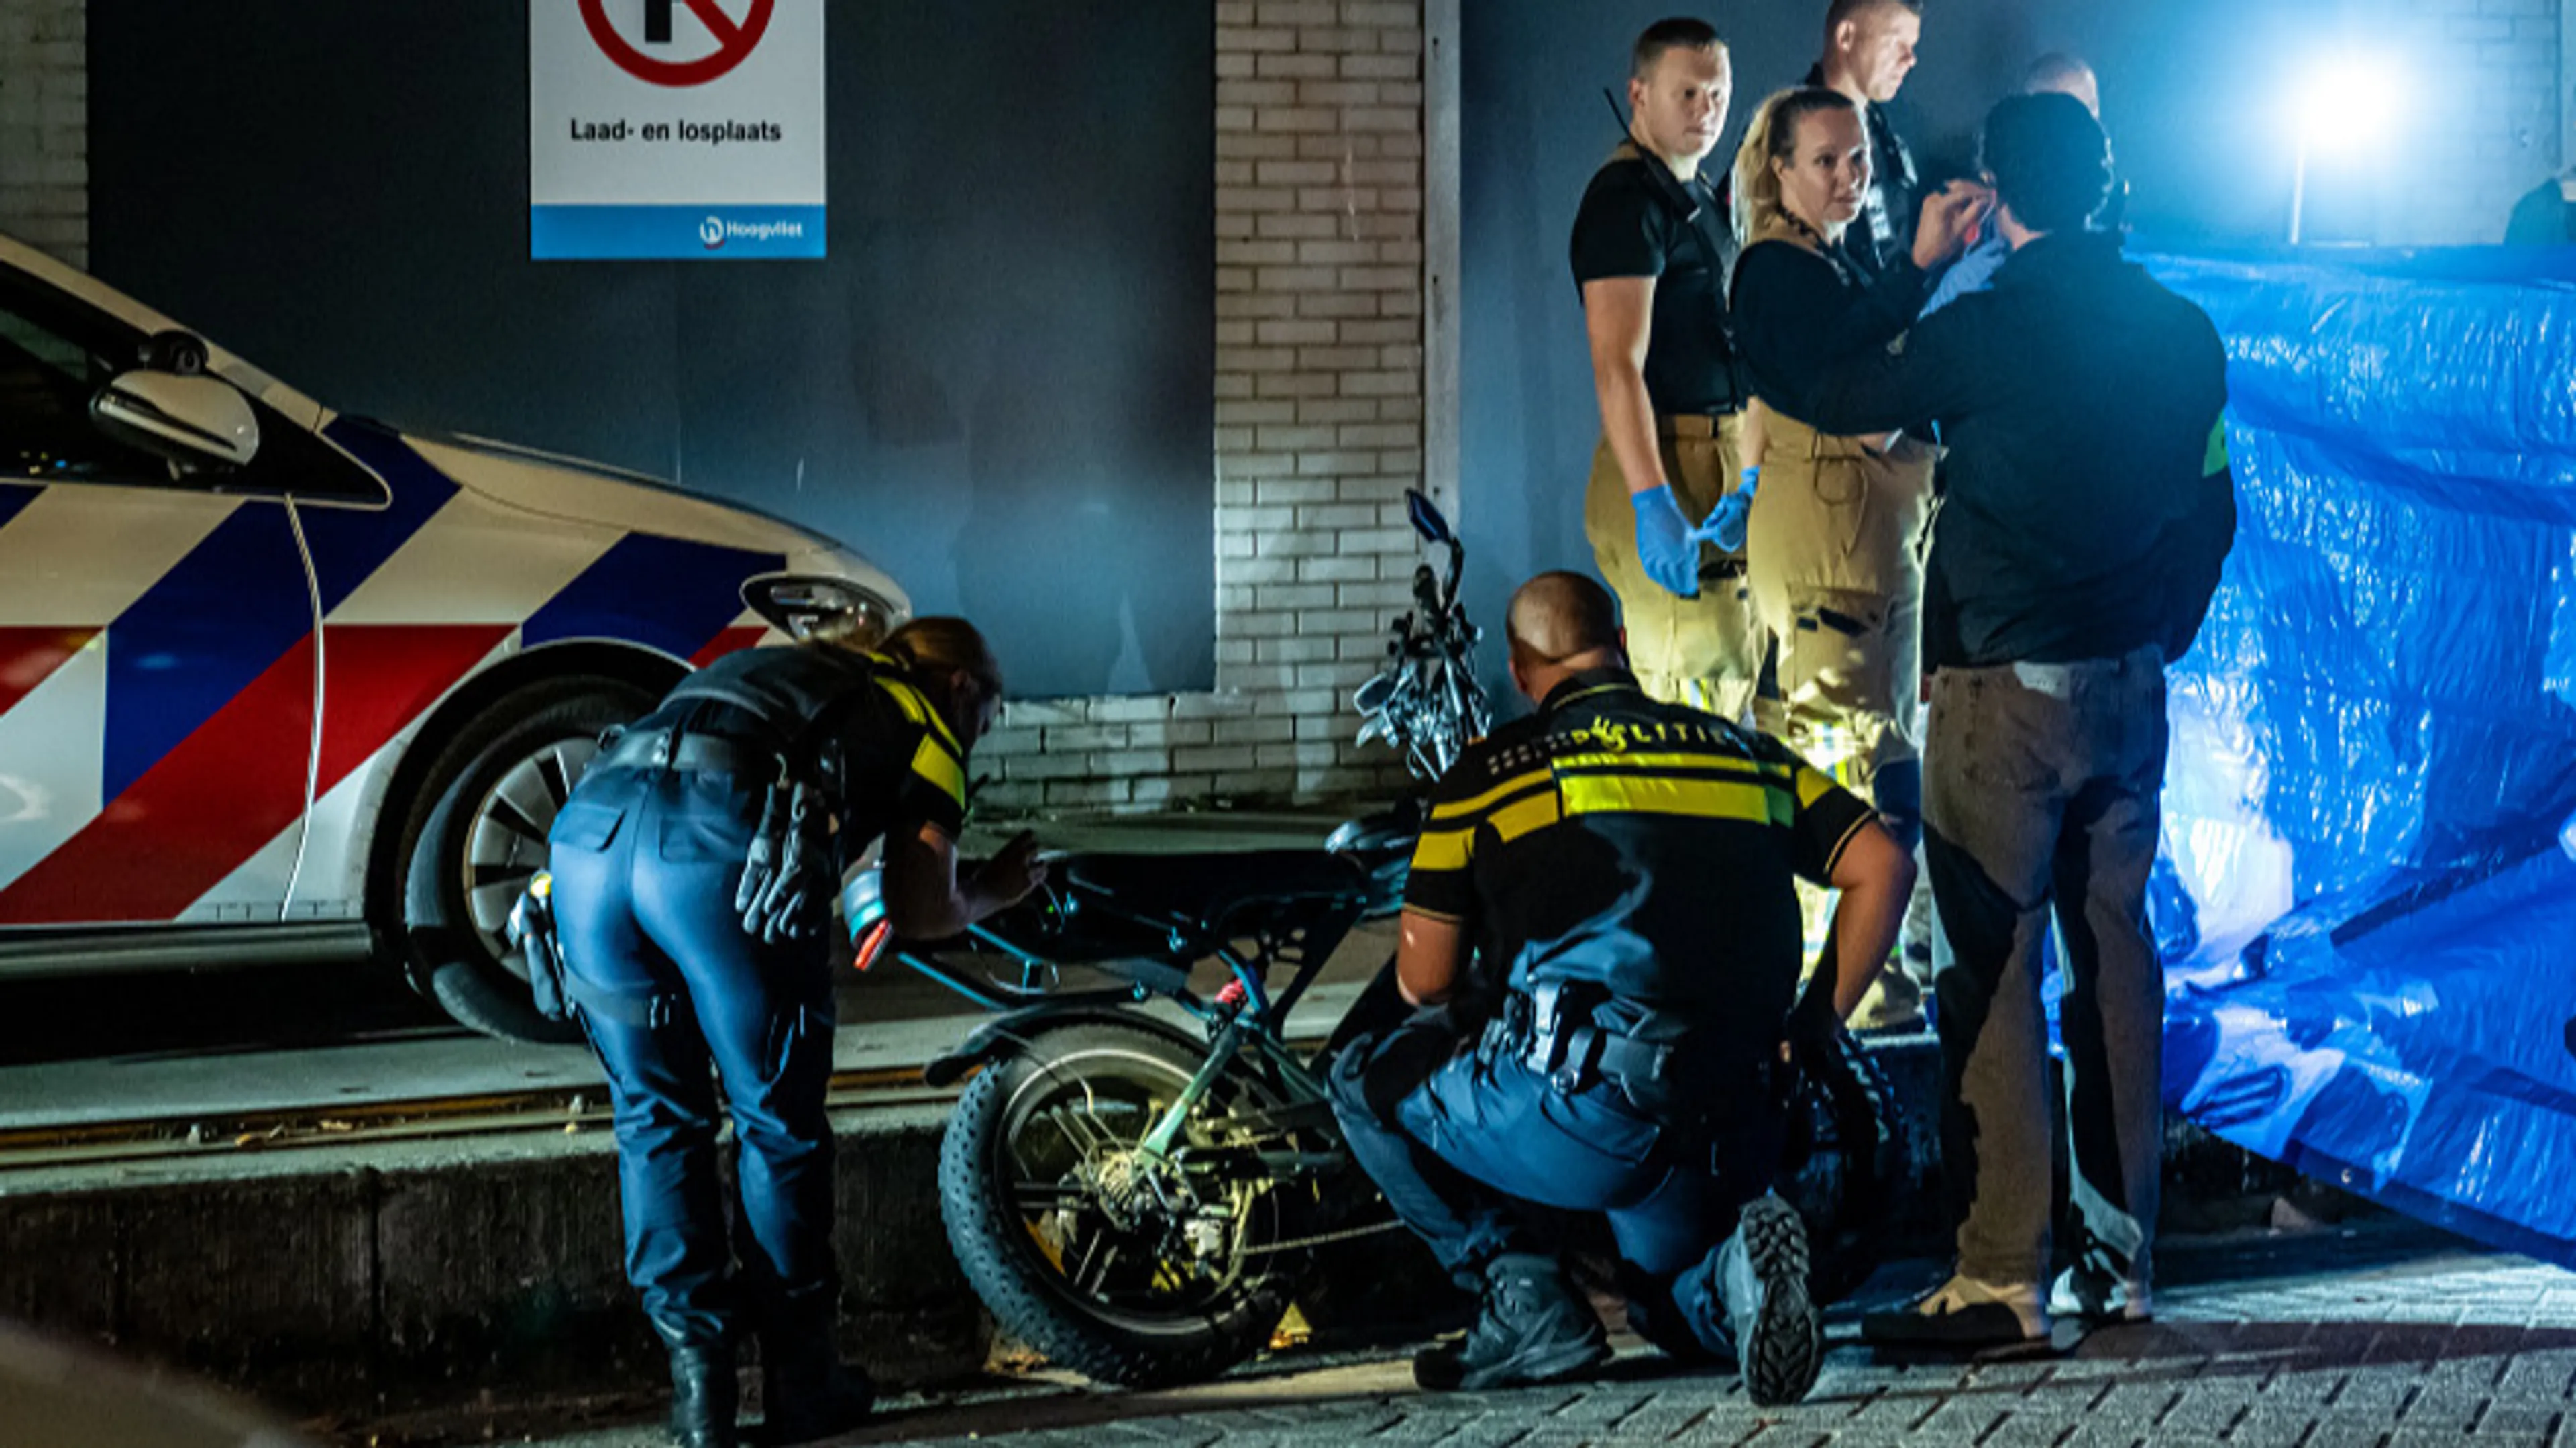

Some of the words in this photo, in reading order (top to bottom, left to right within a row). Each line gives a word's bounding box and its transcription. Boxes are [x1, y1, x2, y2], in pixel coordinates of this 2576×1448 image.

[570, 118, 634, 142] Laad-
[641, 123, 670, 142] en
[679, 119, 782, 146] losplaats
[726, 220, 803, 240] Hoogvliet
